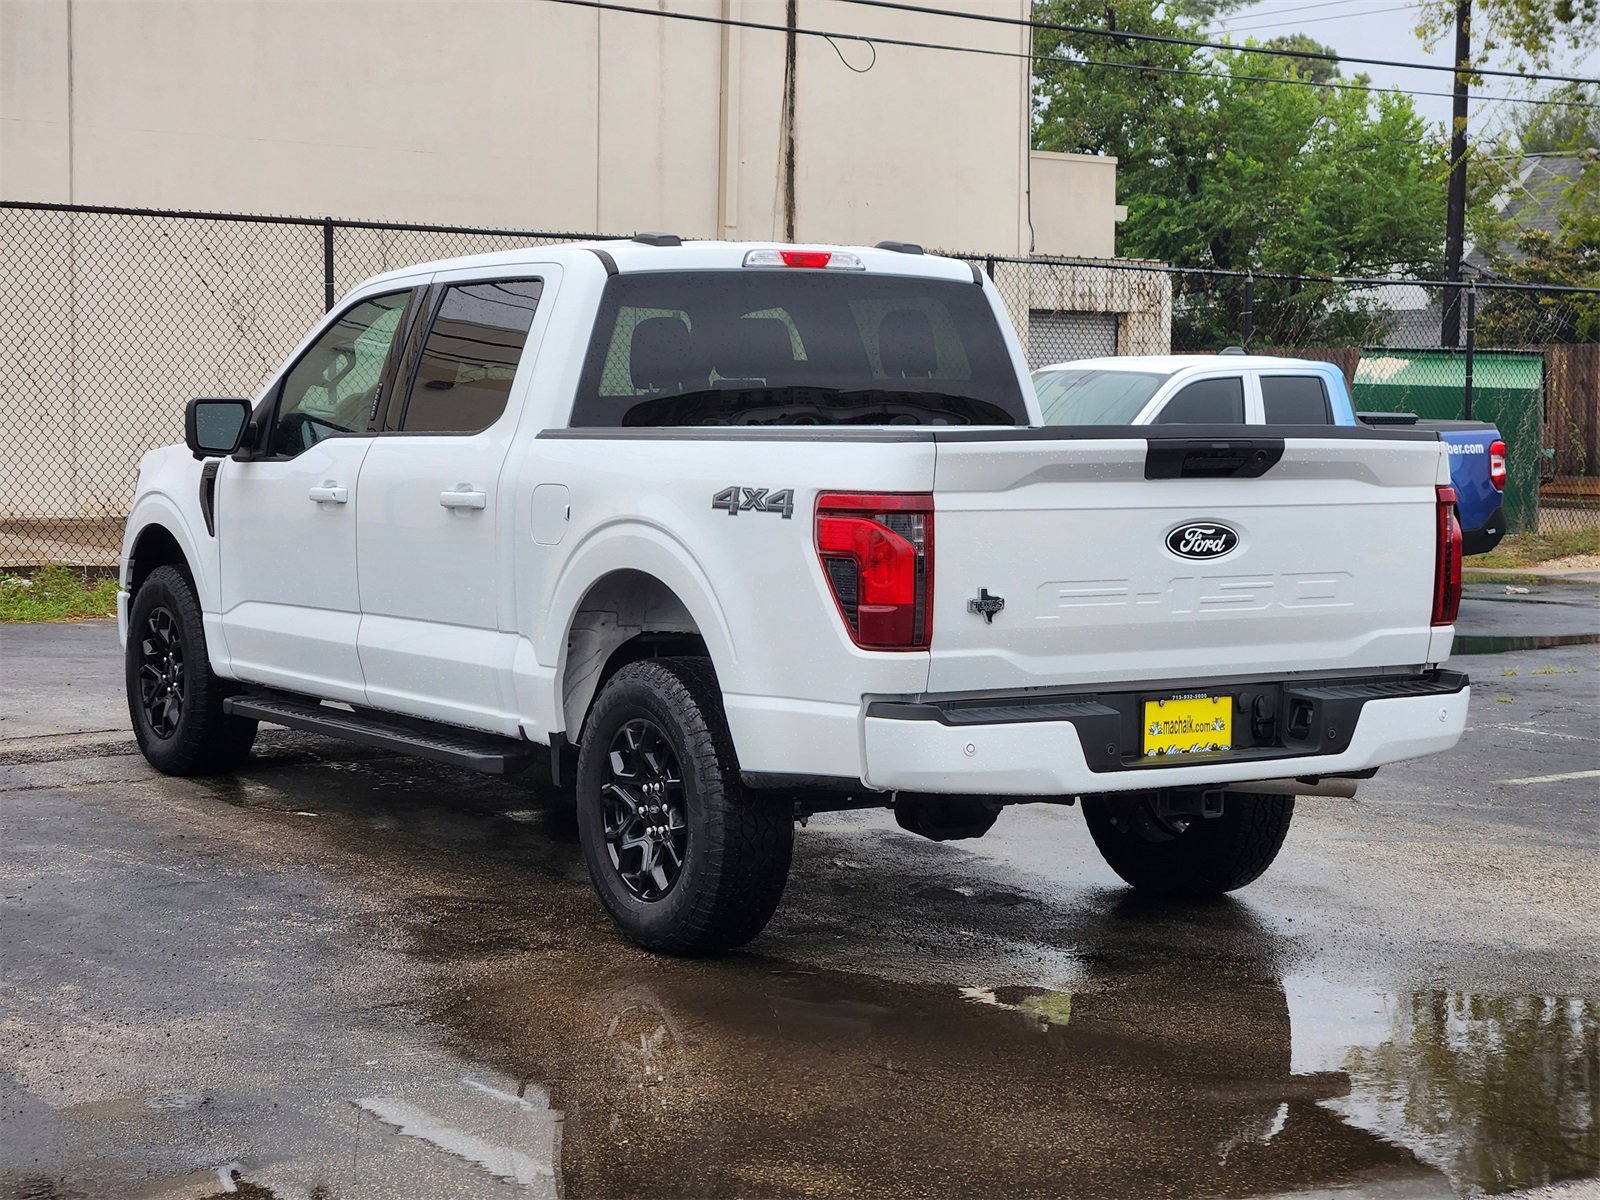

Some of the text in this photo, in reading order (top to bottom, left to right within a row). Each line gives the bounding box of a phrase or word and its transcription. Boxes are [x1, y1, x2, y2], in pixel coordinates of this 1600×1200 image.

[1180, 528, 1226, 552] Ford
[971, 600, 1003, 610] TEXAS
[1035, 571, 1354, 619] F-150
[1163, 715, 1211, 735] machaik.com
